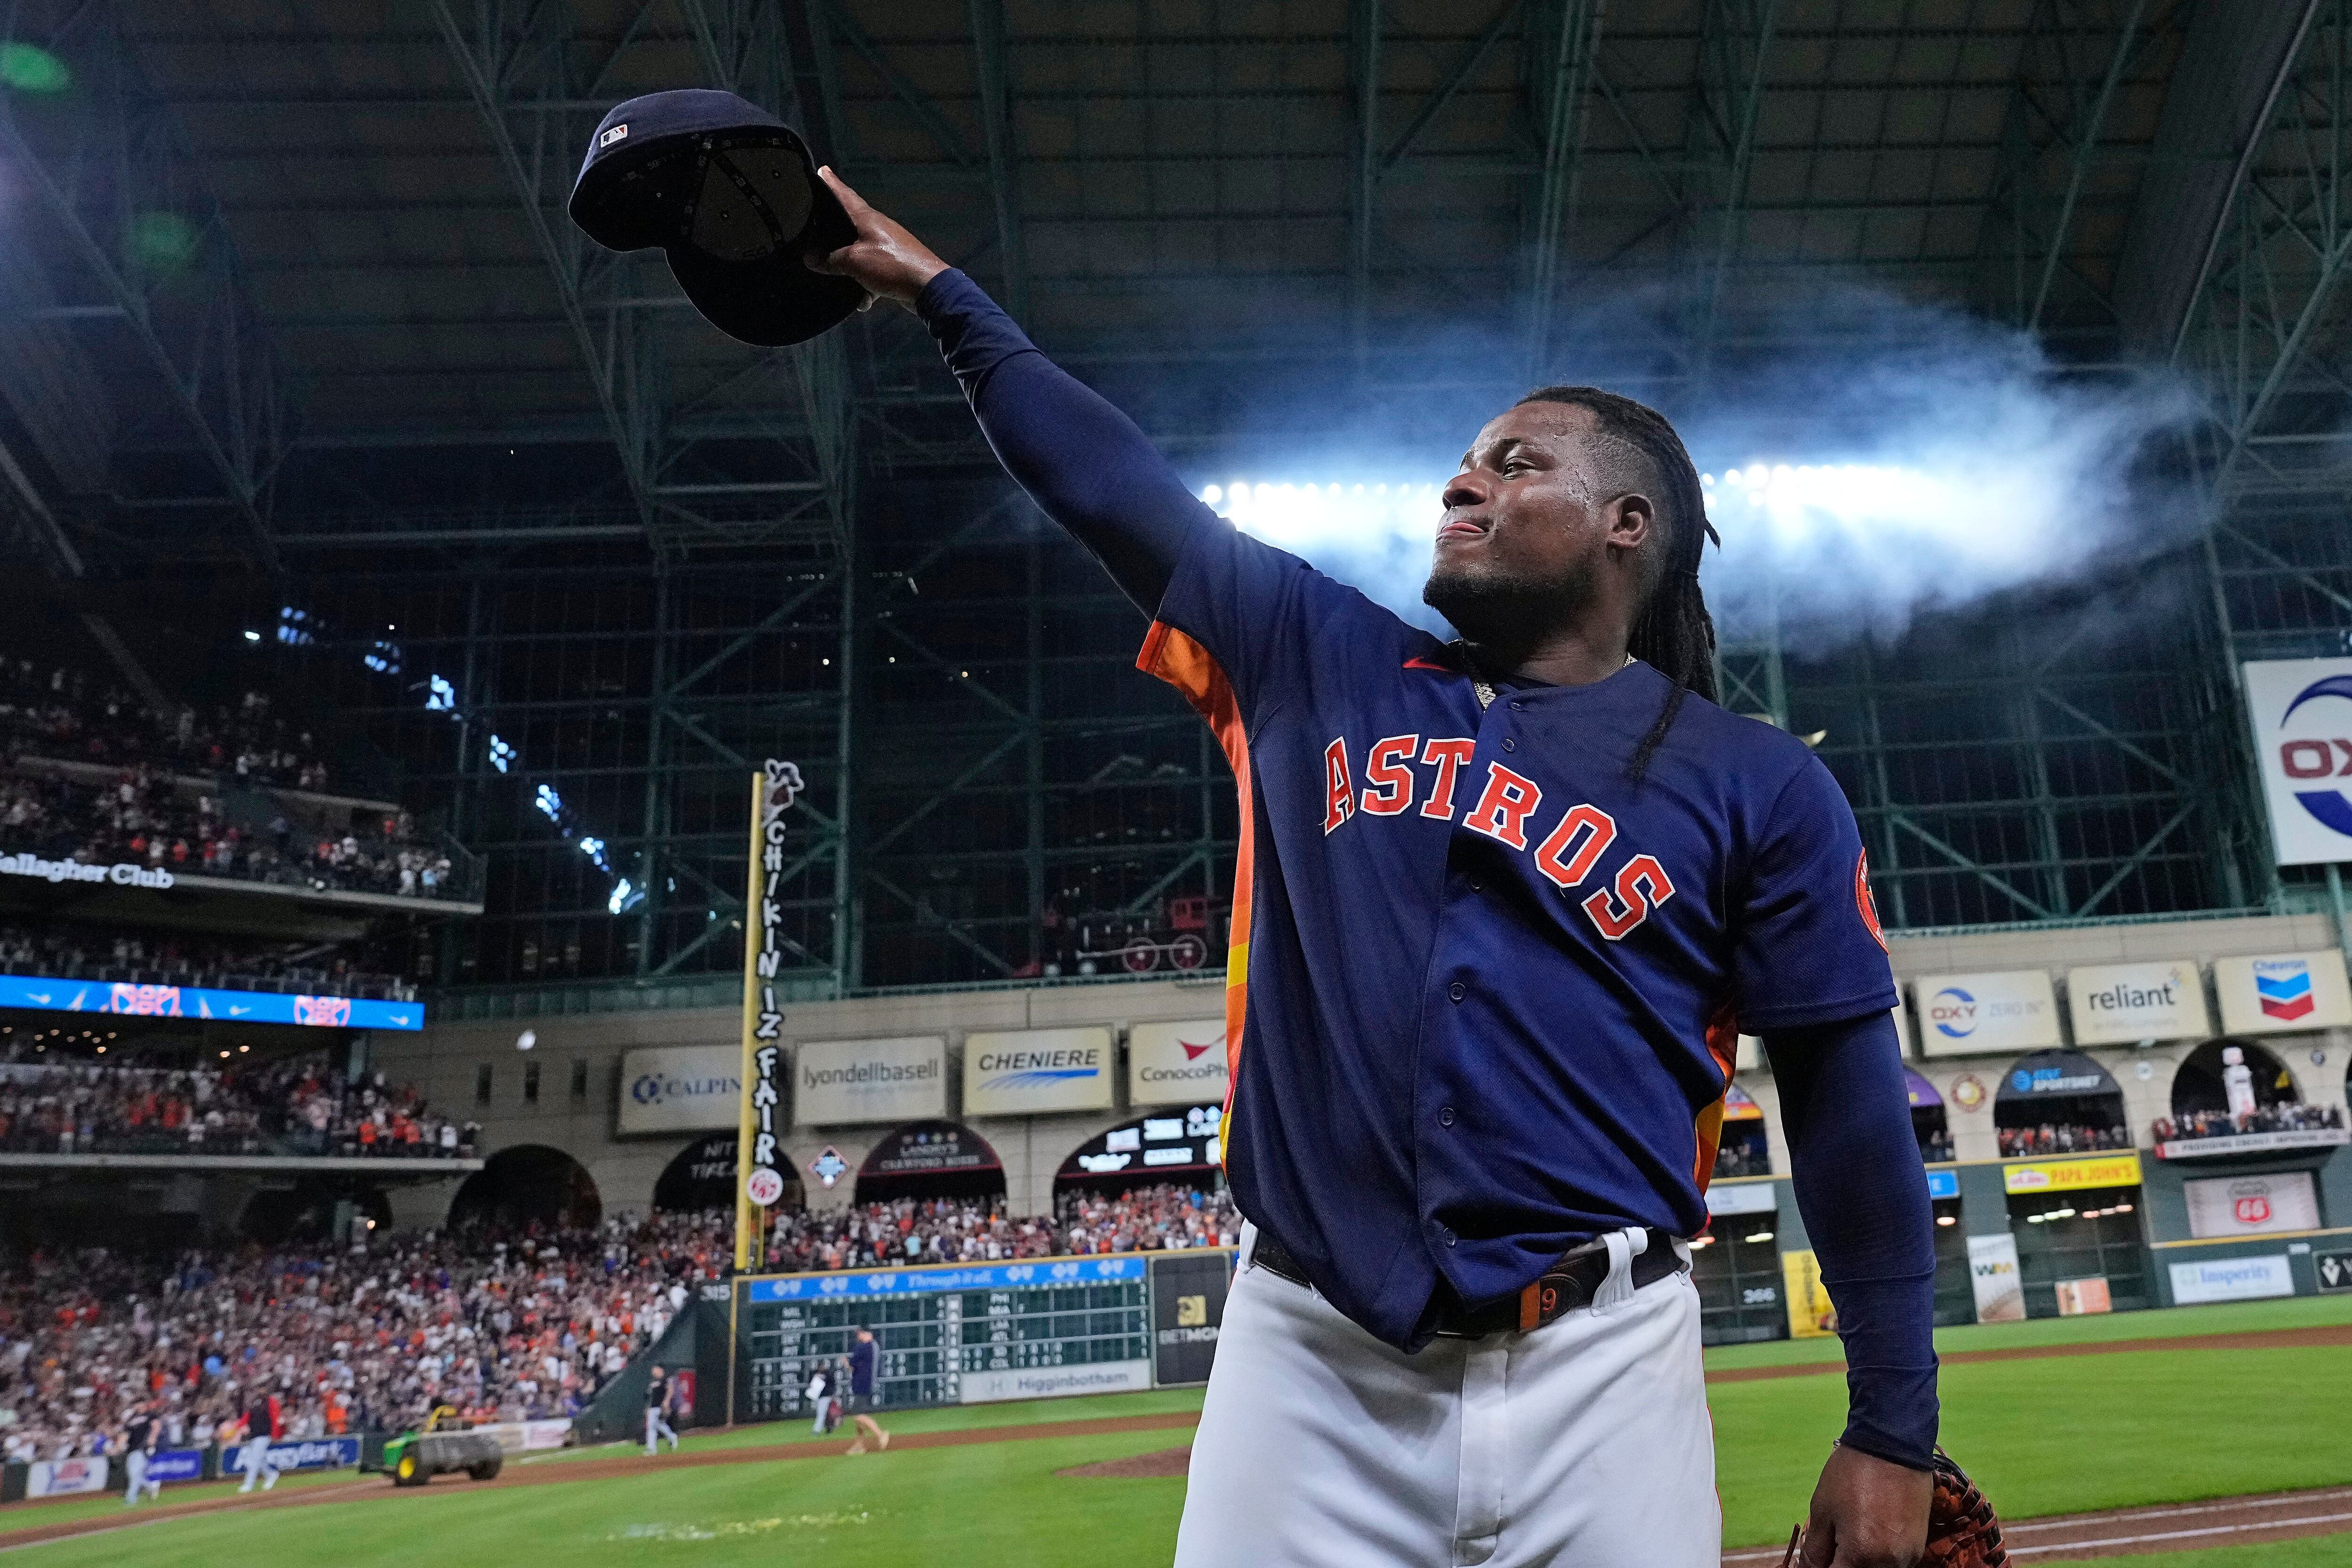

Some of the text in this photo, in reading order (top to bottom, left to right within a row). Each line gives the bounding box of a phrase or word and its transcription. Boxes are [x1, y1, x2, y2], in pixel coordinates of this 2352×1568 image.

[1325, 733, 1676, 940] ASTROS
[0, 851, 175, 889] allagher Club
[757, 820, 786, 979] CHIKIN
[2089, 982, 2176, 1010] reliant
[756, 987, 782, 1038] IZ
[1931, 1004, 1977, 1020] OXY
[803, 1059, 938, 1090] lyondellbasell
[978, 1048, 1100, 1071] CHENIERE
[755, 1046, 779, 1165] FAIR
[2240, 1200, 2264, 1218] 66
[1017, 1368, 1129, 1392] Higginbotham
